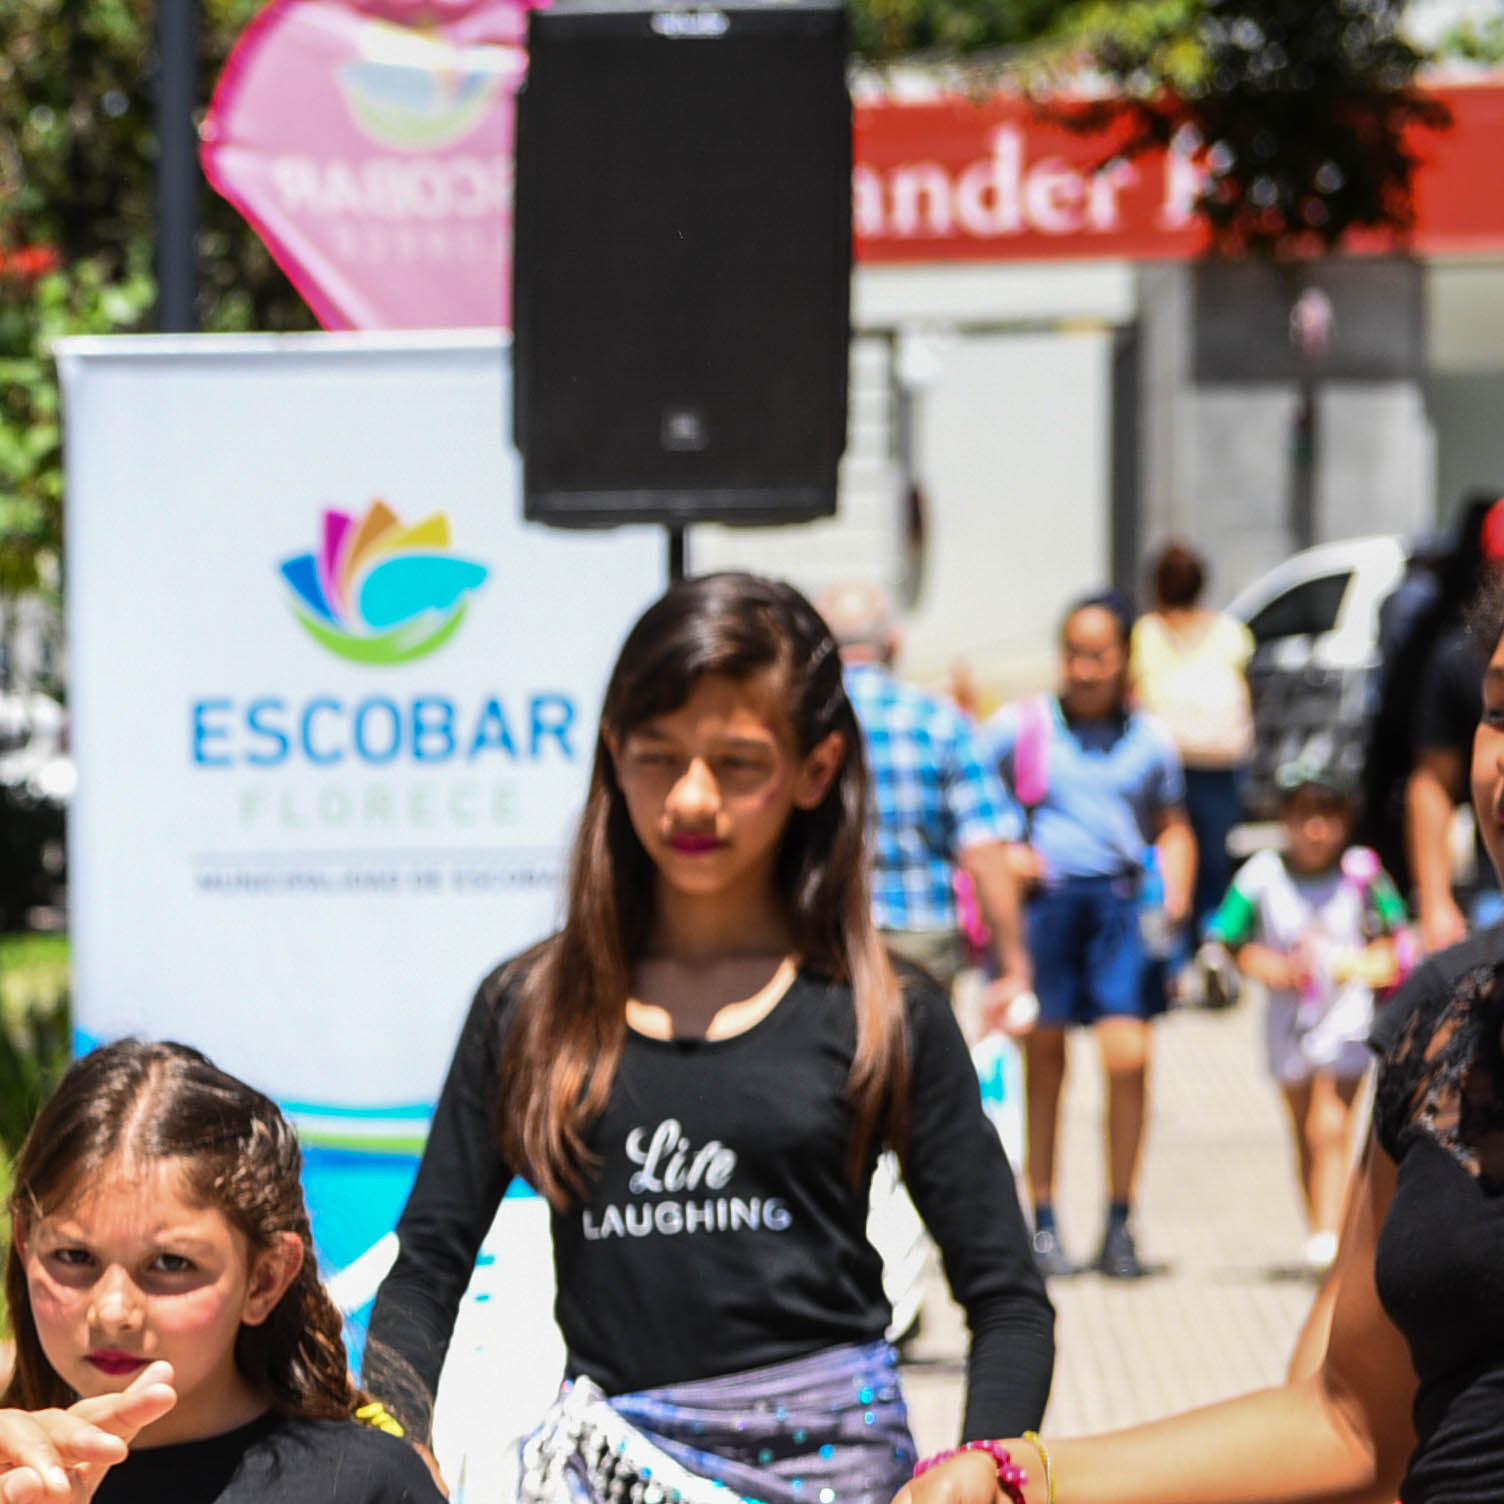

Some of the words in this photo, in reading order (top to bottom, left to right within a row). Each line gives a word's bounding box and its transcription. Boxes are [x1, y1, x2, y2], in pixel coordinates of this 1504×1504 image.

[190, 694, 578, 769] ESCOBAR
[238, 782, 522, 829] FLORECE
[582, 1196, 793, 1241] LAUGHING
